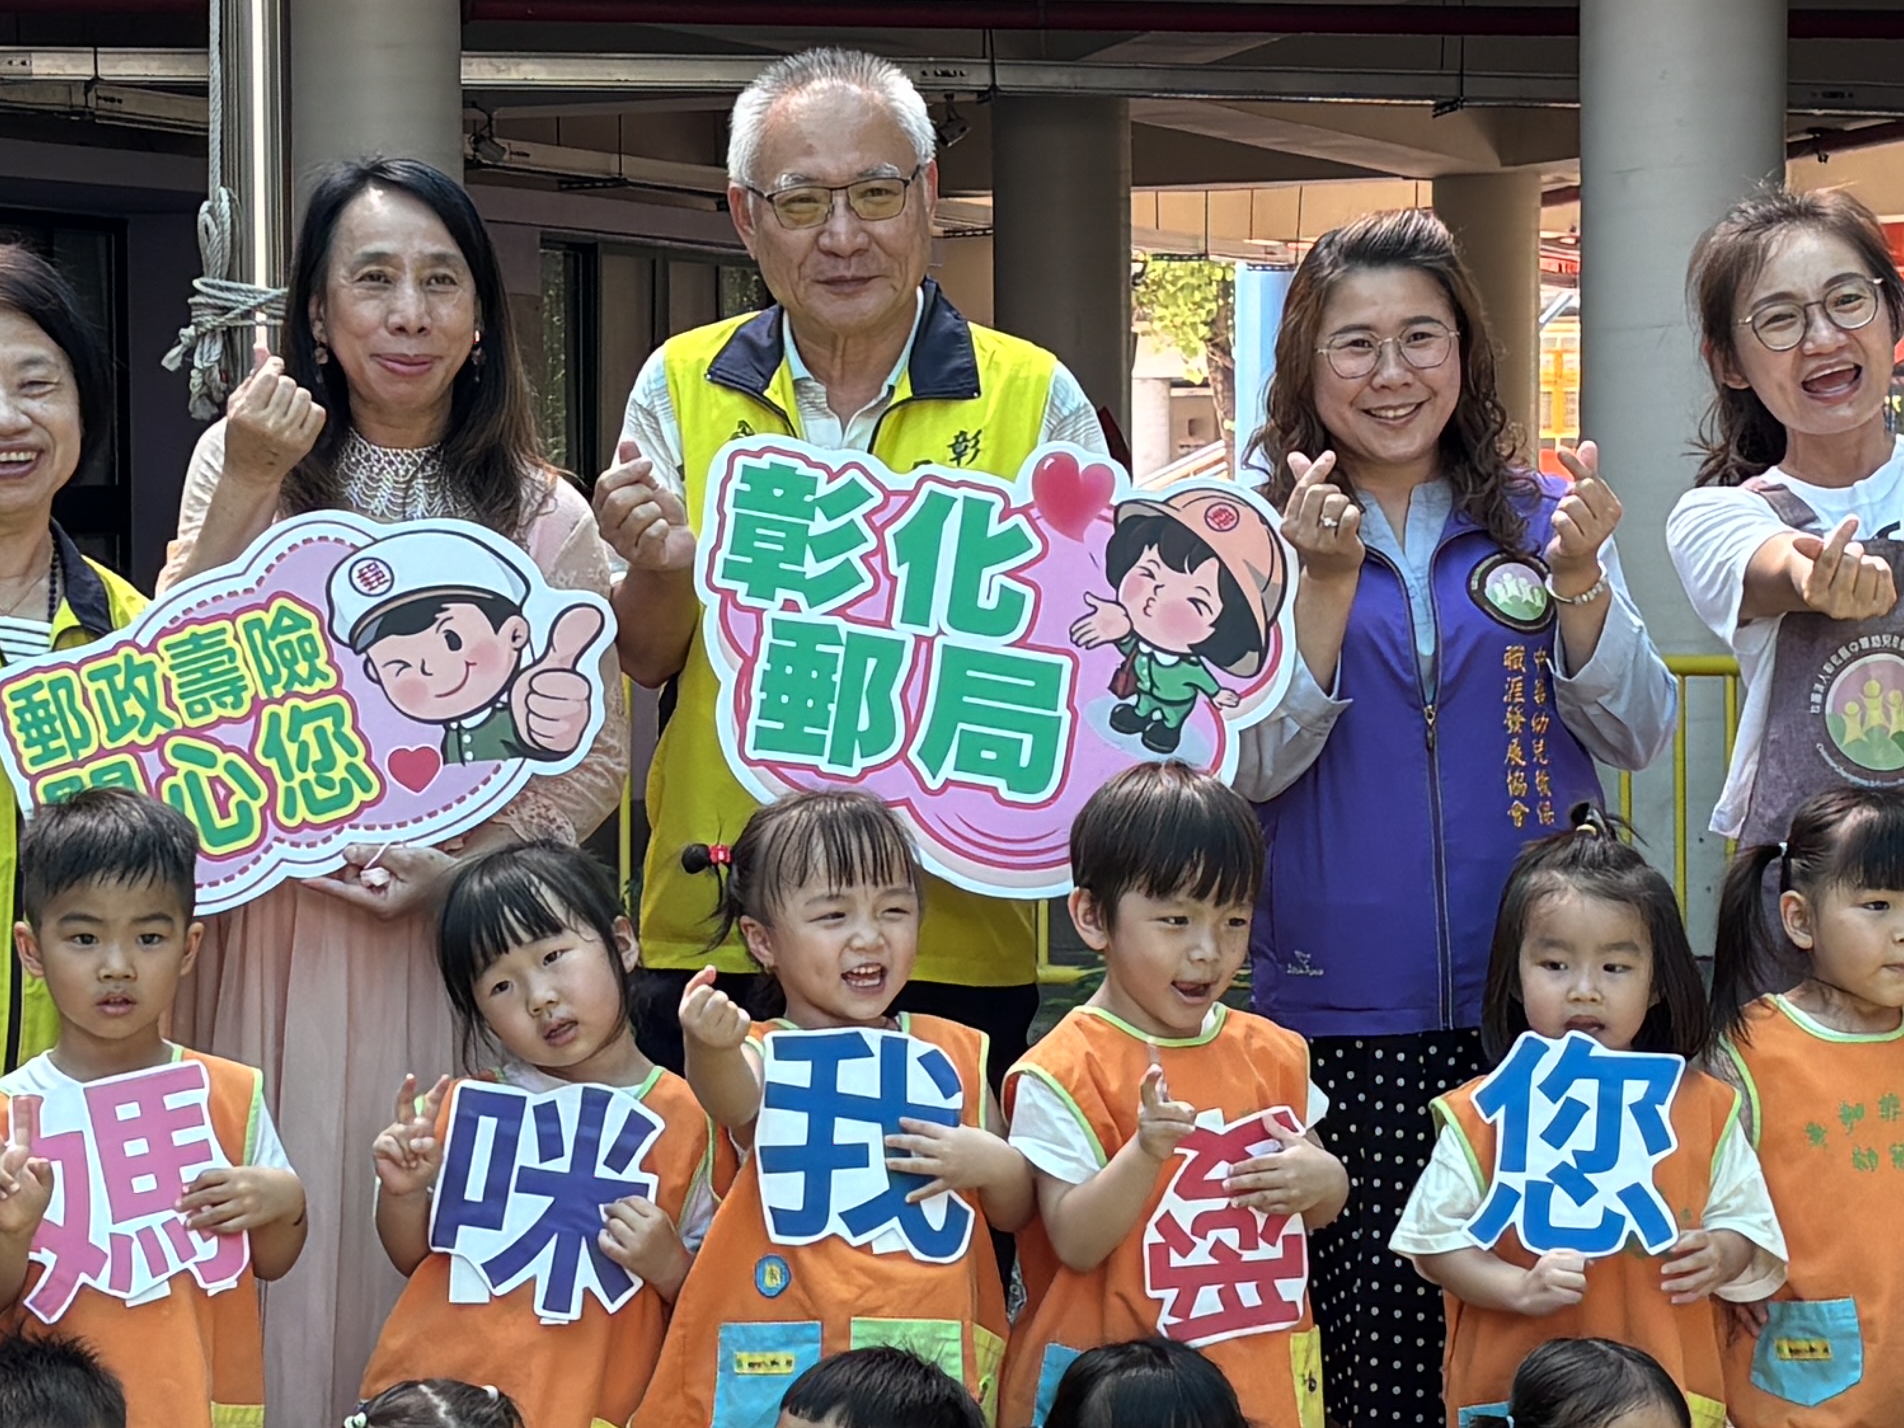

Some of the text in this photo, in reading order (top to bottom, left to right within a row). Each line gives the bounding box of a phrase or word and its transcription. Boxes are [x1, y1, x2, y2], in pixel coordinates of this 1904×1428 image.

[722, 461, 1037, 638] 彰化
[9, 604, 332, 768] 郵政壽險
[753, 617, 1072, 795] 郵局
[10, 1064, 249, 1321] 媽
[431, 1085, 658, 1314] 咪
[760, 1032, 971, 1260] 我
[1464, 1033, 1682, 1254] 您
